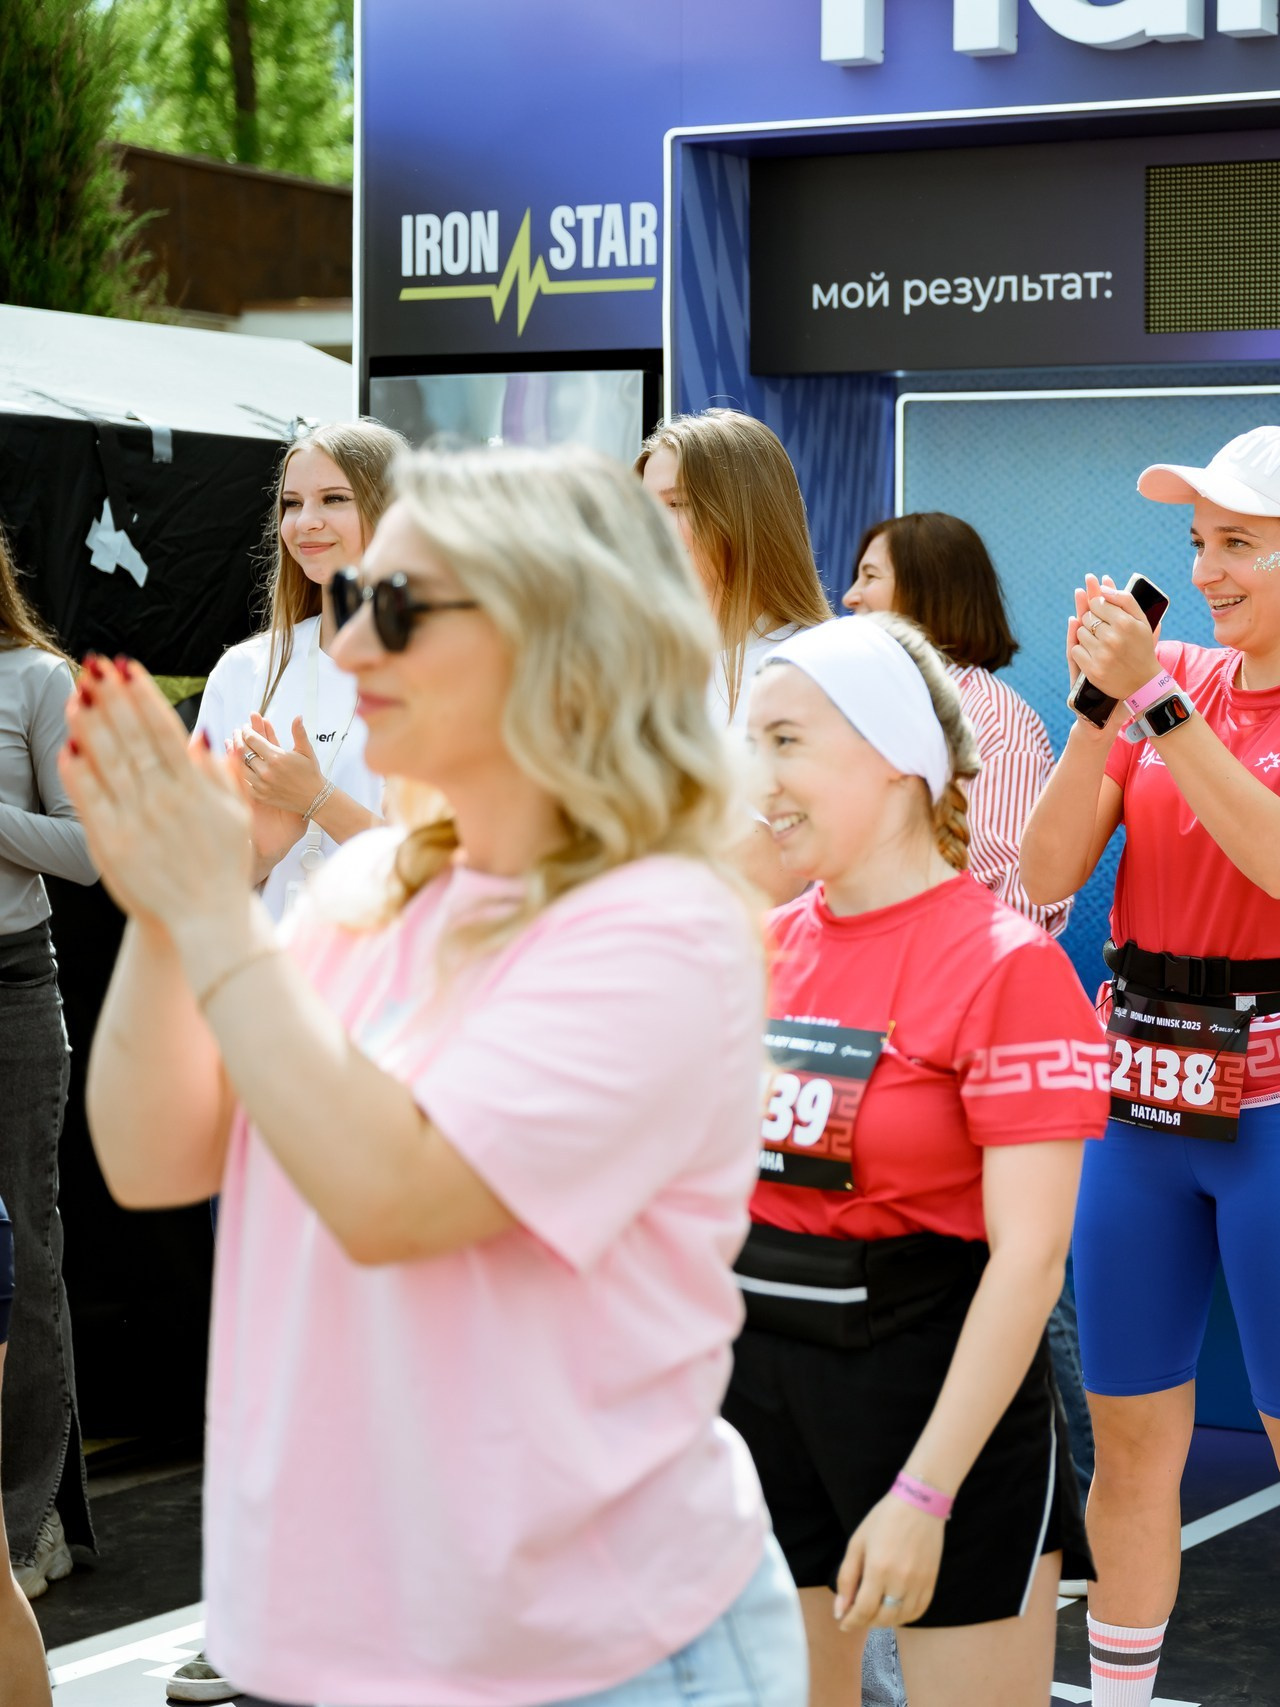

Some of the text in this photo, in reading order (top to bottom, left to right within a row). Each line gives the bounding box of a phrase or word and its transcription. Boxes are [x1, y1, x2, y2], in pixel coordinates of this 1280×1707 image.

[401, 201, 658, 277] IRON STAR
[812, 271, 1112, 316] мой результат:
[1156, 1016, 1180, 1029] MINSK
[1181, 1019, 1202, 1031] 2025
[1110, 1039, 1217, 1106] 2138
[1131, 1103, 1181, 1126] НАТАЛЬЯ
